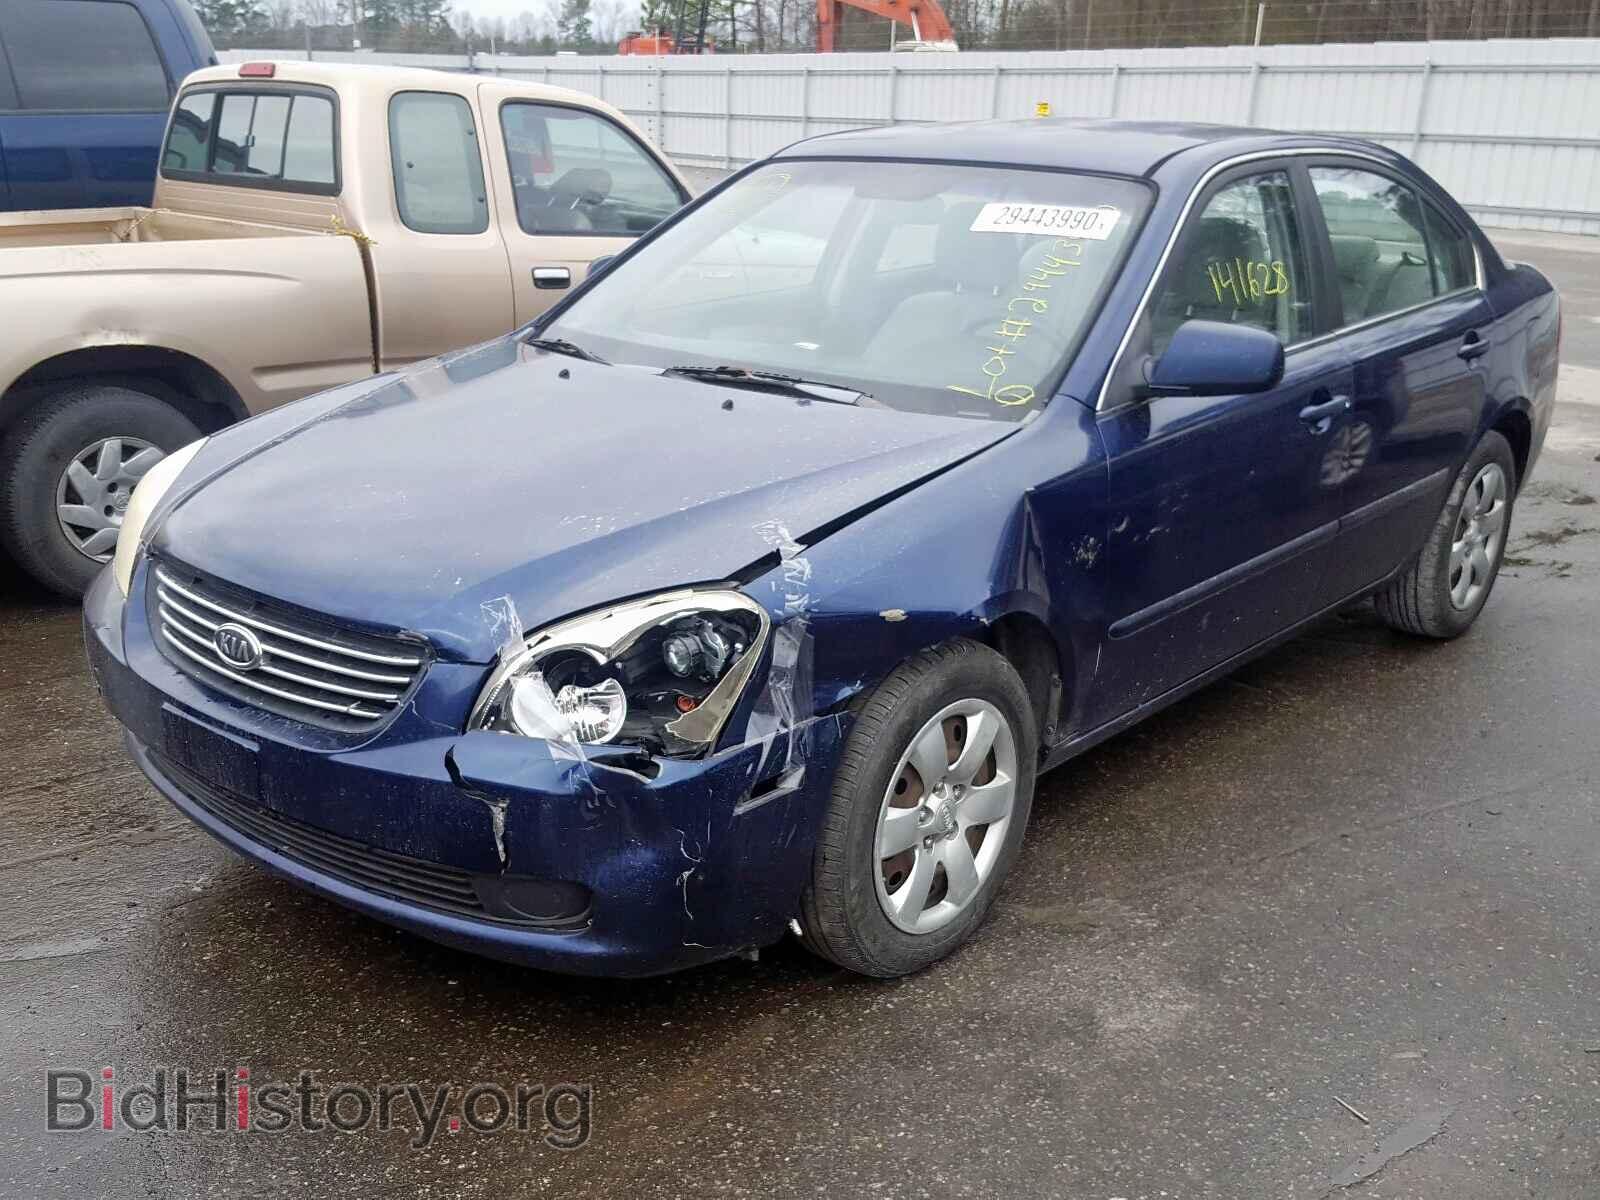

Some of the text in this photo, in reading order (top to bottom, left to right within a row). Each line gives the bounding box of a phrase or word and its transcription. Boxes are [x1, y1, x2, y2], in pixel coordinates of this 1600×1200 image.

[993, 205, 1099, 231] 29443990
[1207, 257, 1288, 304] 141628
[219, 630, 250, 662] KIA
